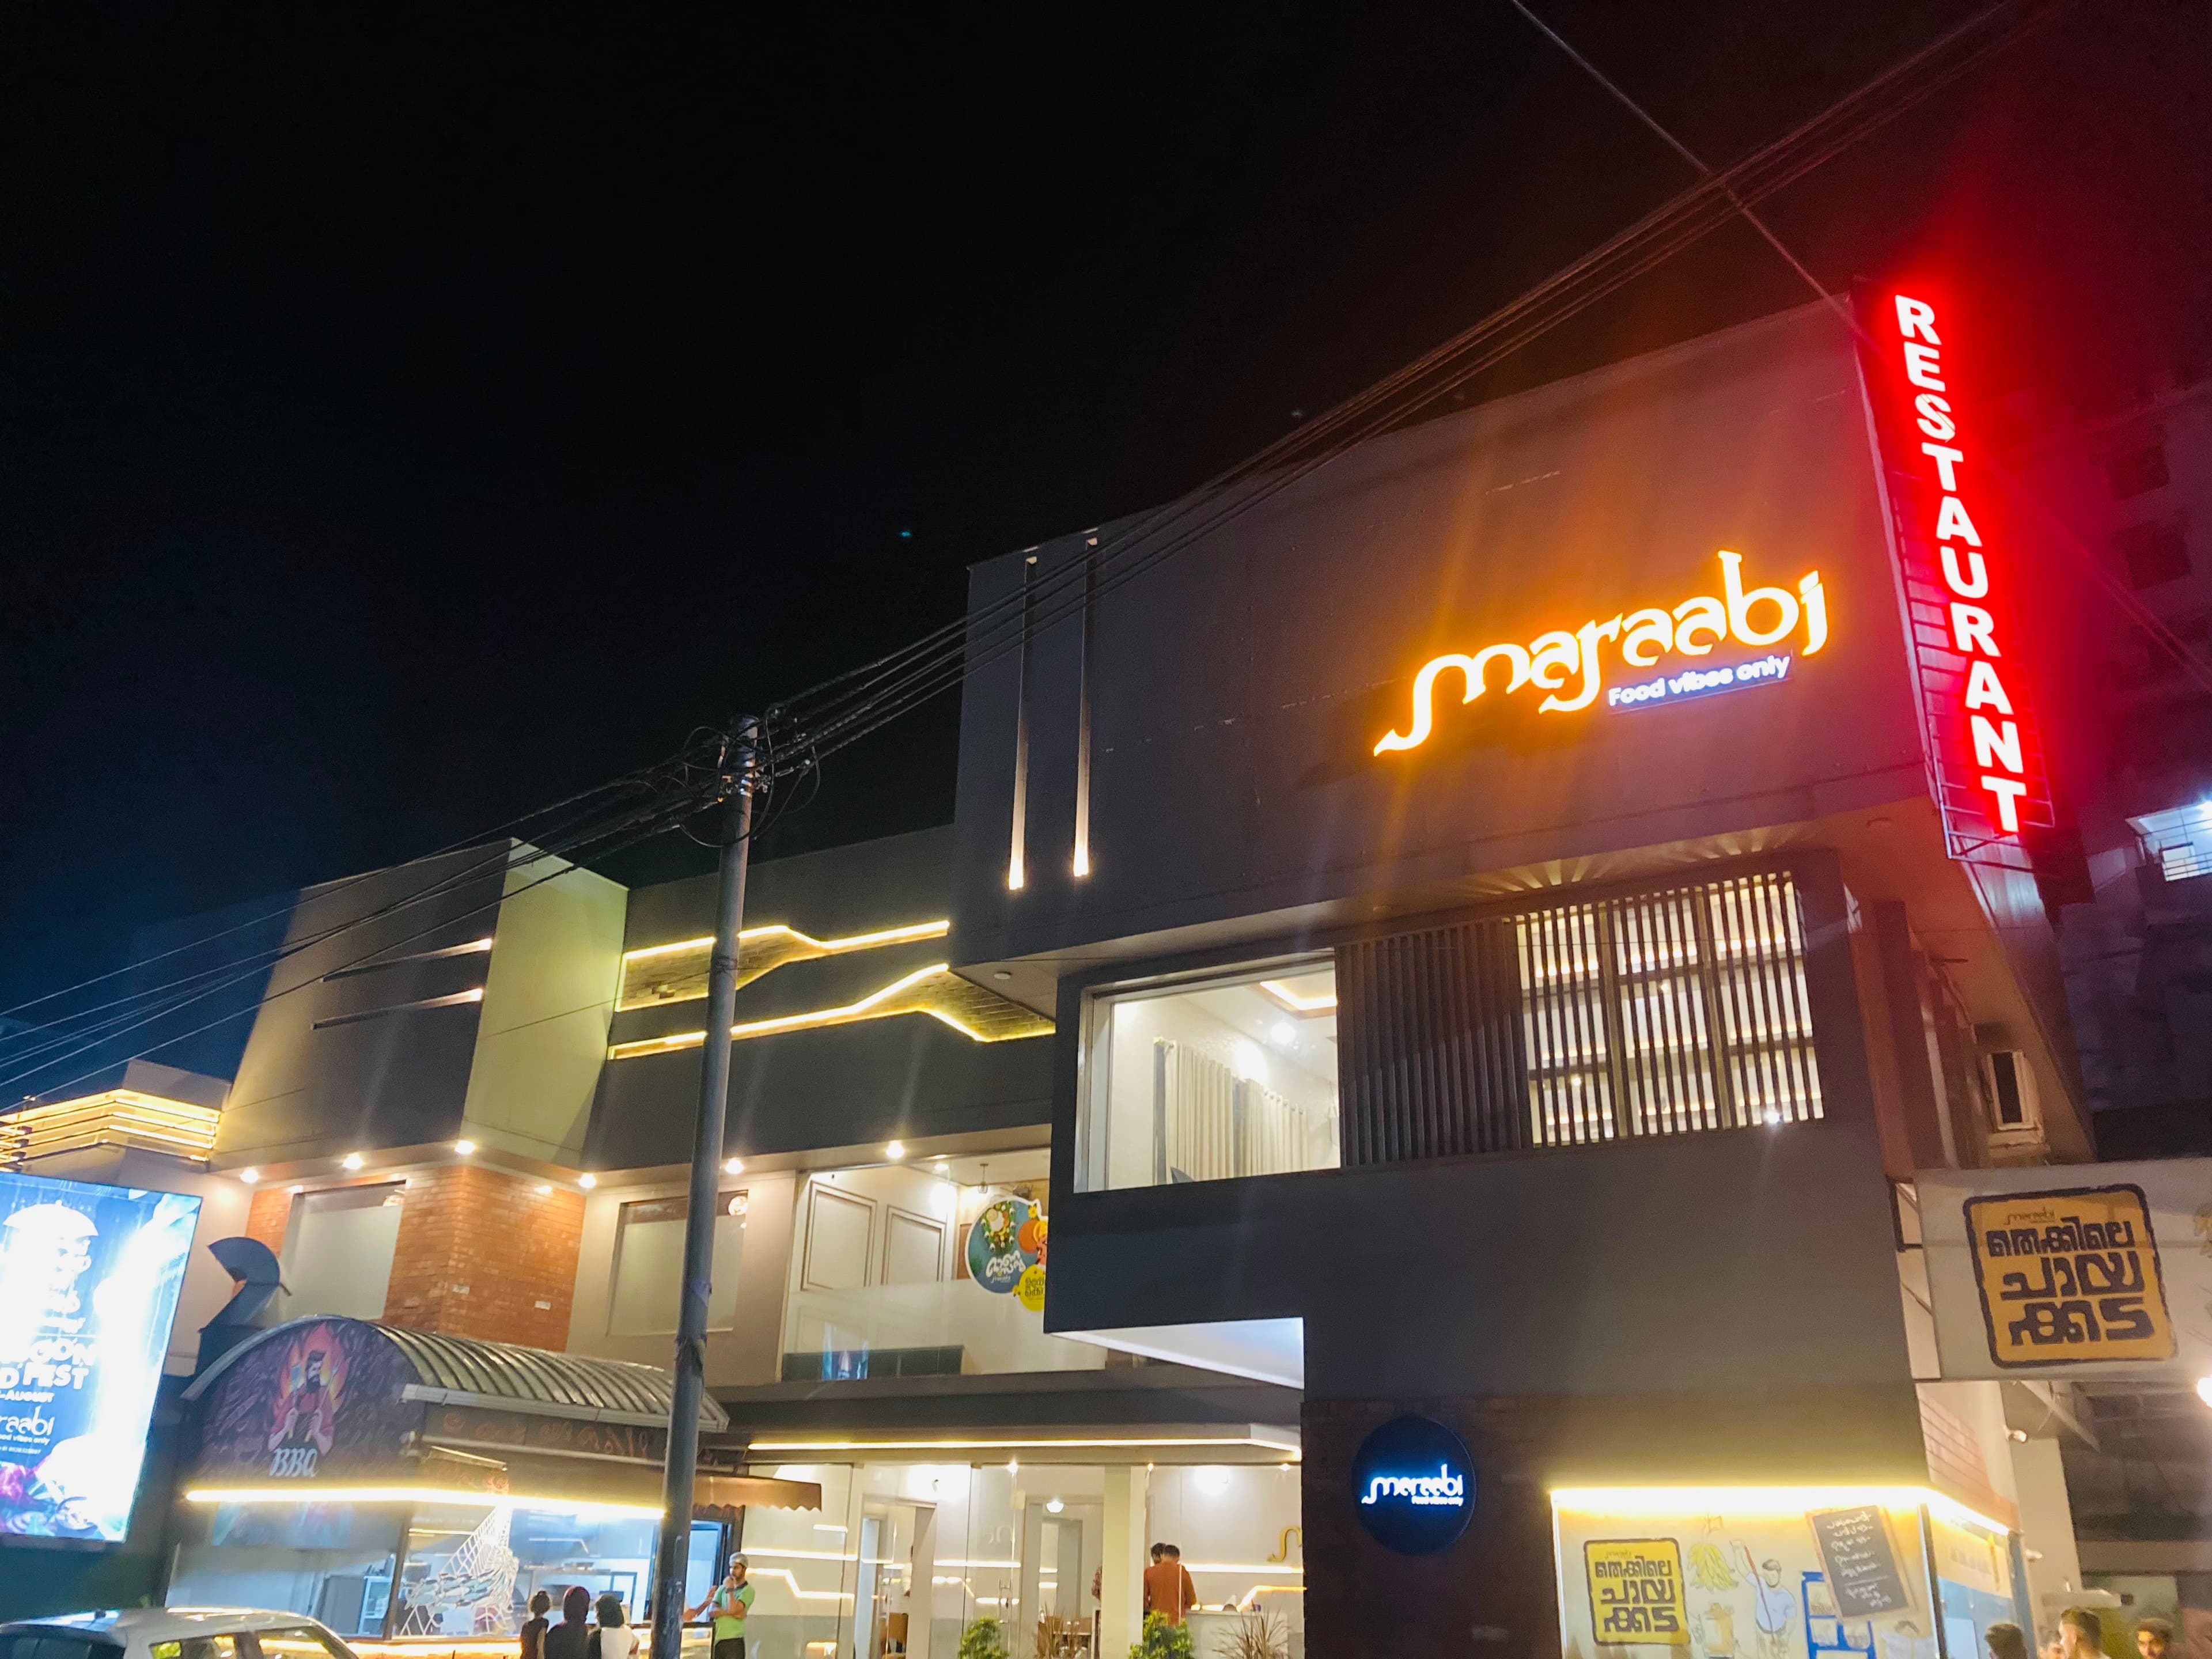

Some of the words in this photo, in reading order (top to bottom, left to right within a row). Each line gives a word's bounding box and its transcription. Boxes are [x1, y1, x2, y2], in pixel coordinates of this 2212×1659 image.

[1608, 677, 1666, 706] Food
[1736, 655, 1790, 679] only
[1895, 294, 2027, 833] RESTAURANT
